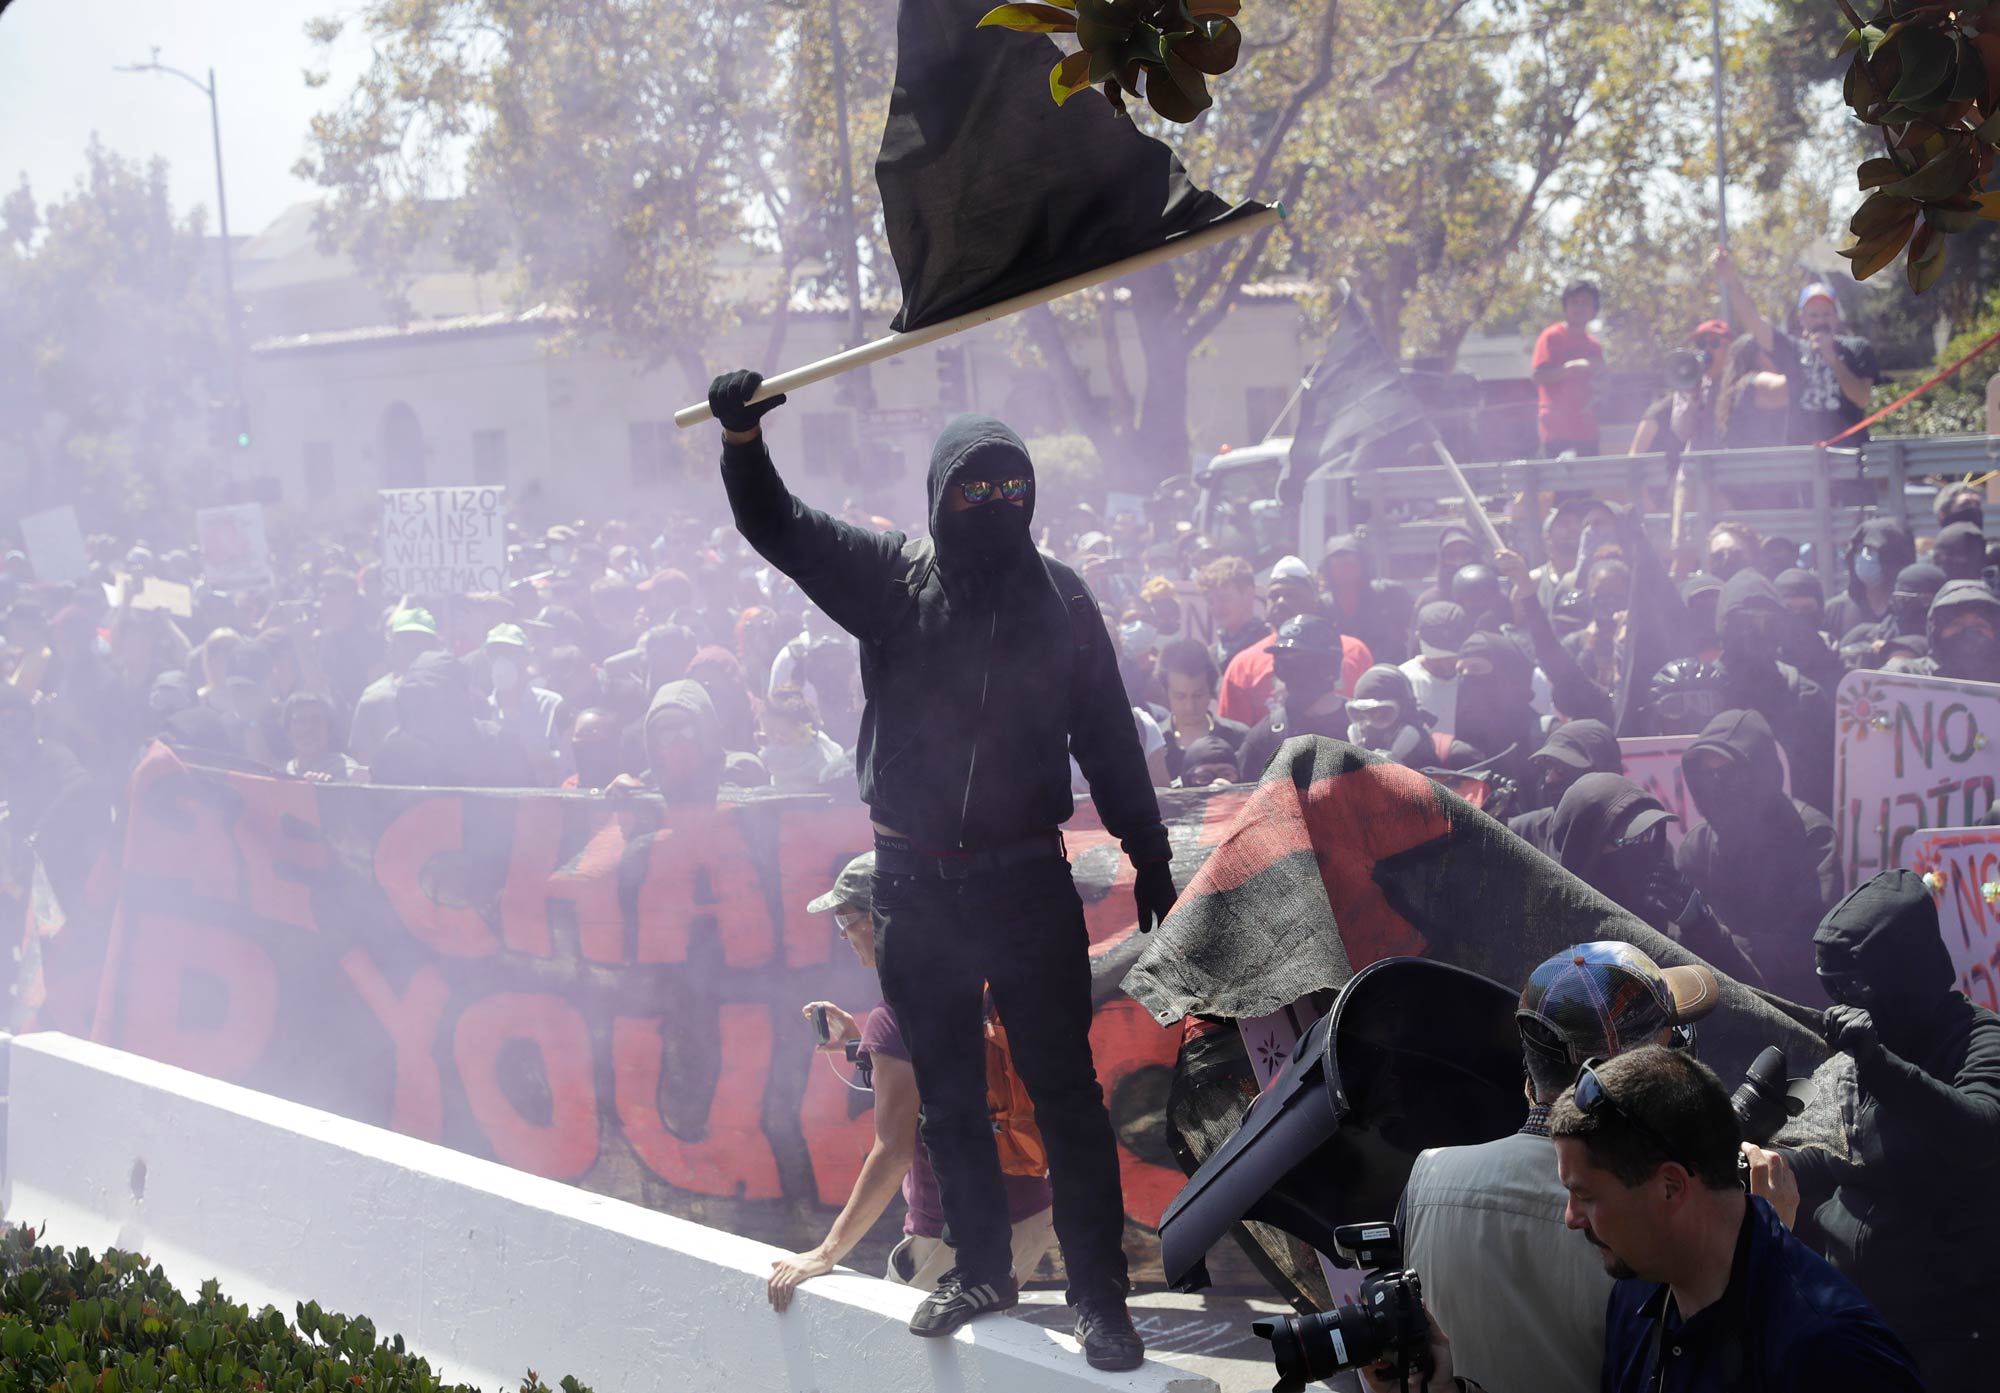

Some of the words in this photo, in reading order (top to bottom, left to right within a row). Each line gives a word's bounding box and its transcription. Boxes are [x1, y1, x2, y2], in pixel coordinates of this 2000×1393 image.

[382, 490, 497, 514] MESTIZO
[386, 513, 497, 540] AGAINST
[393, 540, 482, 565] WHITE
[383, 566, 507, 593] SUPREMACY
[1894, 700, 1979, 778] NO
